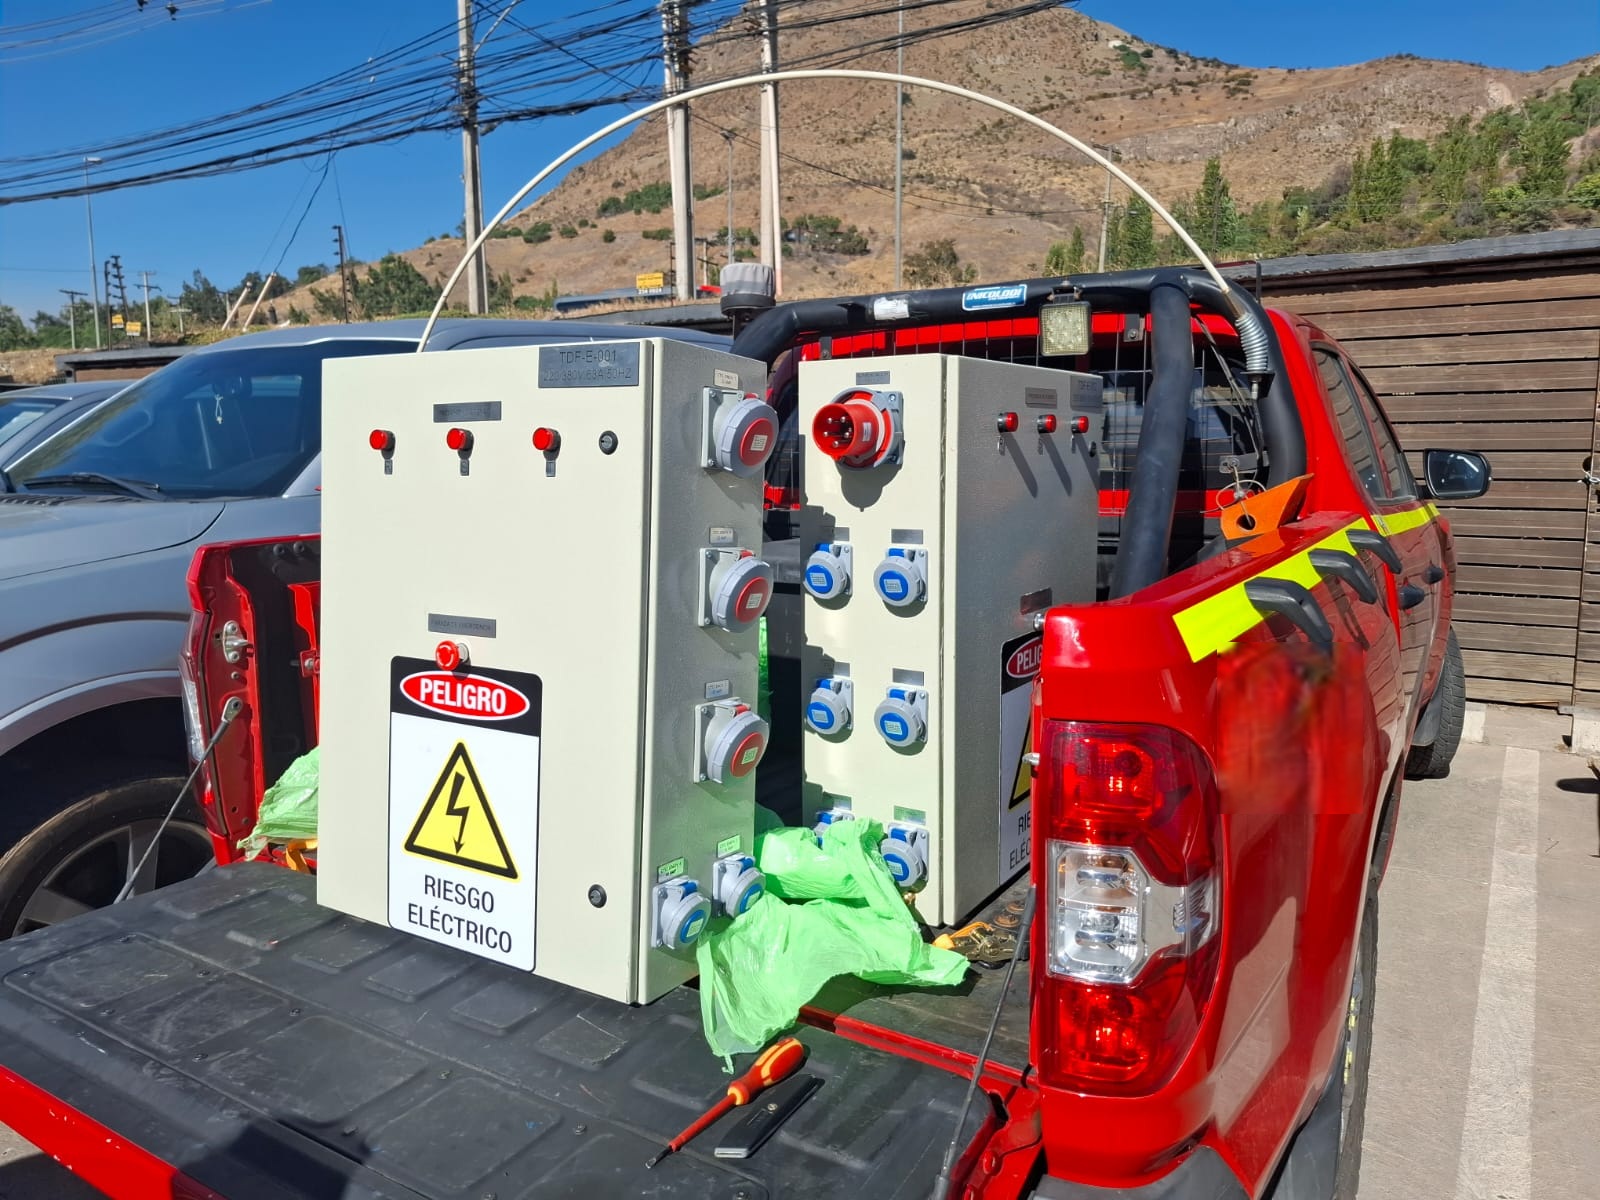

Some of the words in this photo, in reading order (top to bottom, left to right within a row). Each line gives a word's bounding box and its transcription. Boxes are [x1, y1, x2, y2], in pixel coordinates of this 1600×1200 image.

[559, 349, 617, 364] TDF-E-001
[1016, 646, 1042, 673] PELIG
[419, 677, 507, 715] PELIGRO
[1018, 810, 1031, 836] RIE
[424, 873, 495, 913] RIESGO
[408, 902, 513, 953] ELÉCTRICO
